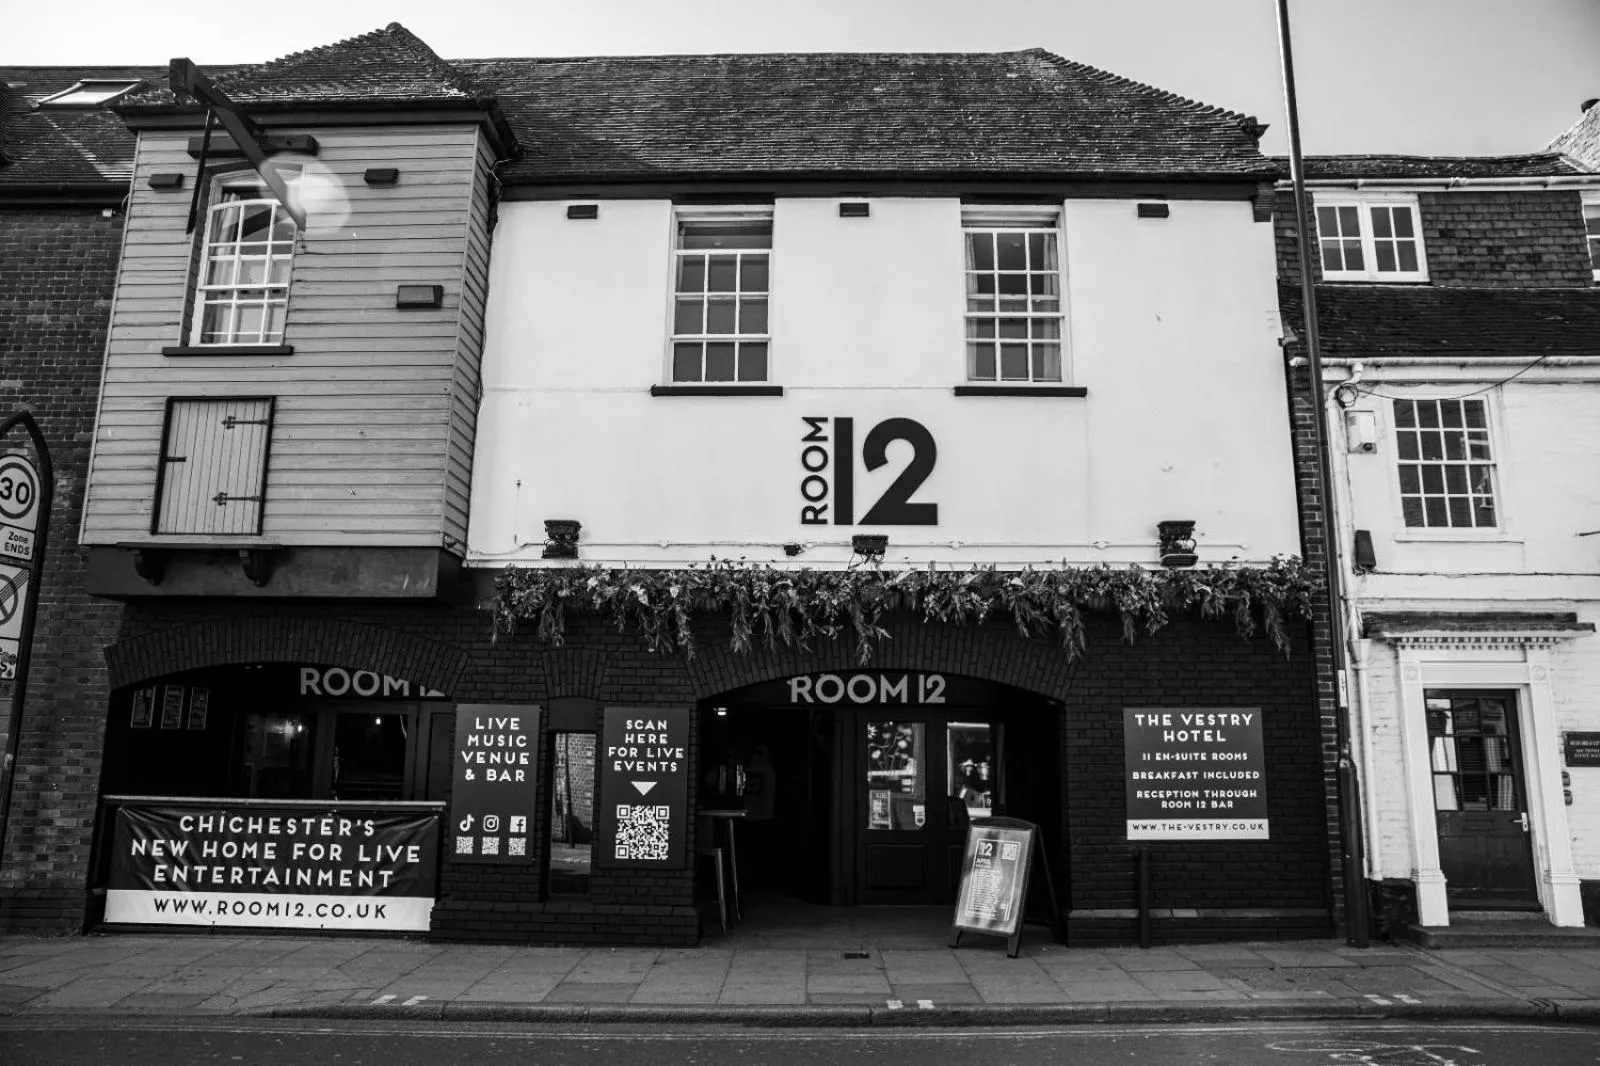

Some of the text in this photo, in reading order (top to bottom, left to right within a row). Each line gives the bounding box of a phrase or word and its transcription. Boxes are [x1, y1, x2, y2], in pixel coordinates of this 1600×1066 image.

[801, 416, 829, 525] ROOM
[834, 416, 938, 526] 12
[0, 476, 30, 505] 30
[8, 531, 29, 544] Zone
[4, 542, 30, 555] ENDS
[300, 667, 410, 697] ROOM
[790, 674, 946, 703] ROOM 12
[475, 717, 521, 730] LIVE
[626, 720, 667, 730] SCAN
[1135, 714, 1253, 726] THE VESTRY
[467, 735, 527, 748] MUSIC
[625, 734, 668, 744] HERE
[1164, 730, 1226, 742] HOTEL
[461, 751, 530, 765] VENUE
[608, 747, 684, 759] FOR LIVE
[613, 761, 678, 772] EVENTS
[465, 769, 525, 782] & BAR
[1132, 772, 1198, 780] BREAKFAST
[1136, 790, 1257, 798] RECEPTION THROUGH
[179, 815, 375, 836] CHICHESTER'S
[131, 839, 420, 862] NEW HOME FOR LIVE
[154, 864, 393, 888] ENTERTAINMENT
[154, 898, 386, 919] WWW.ROOM12.CO.UK
